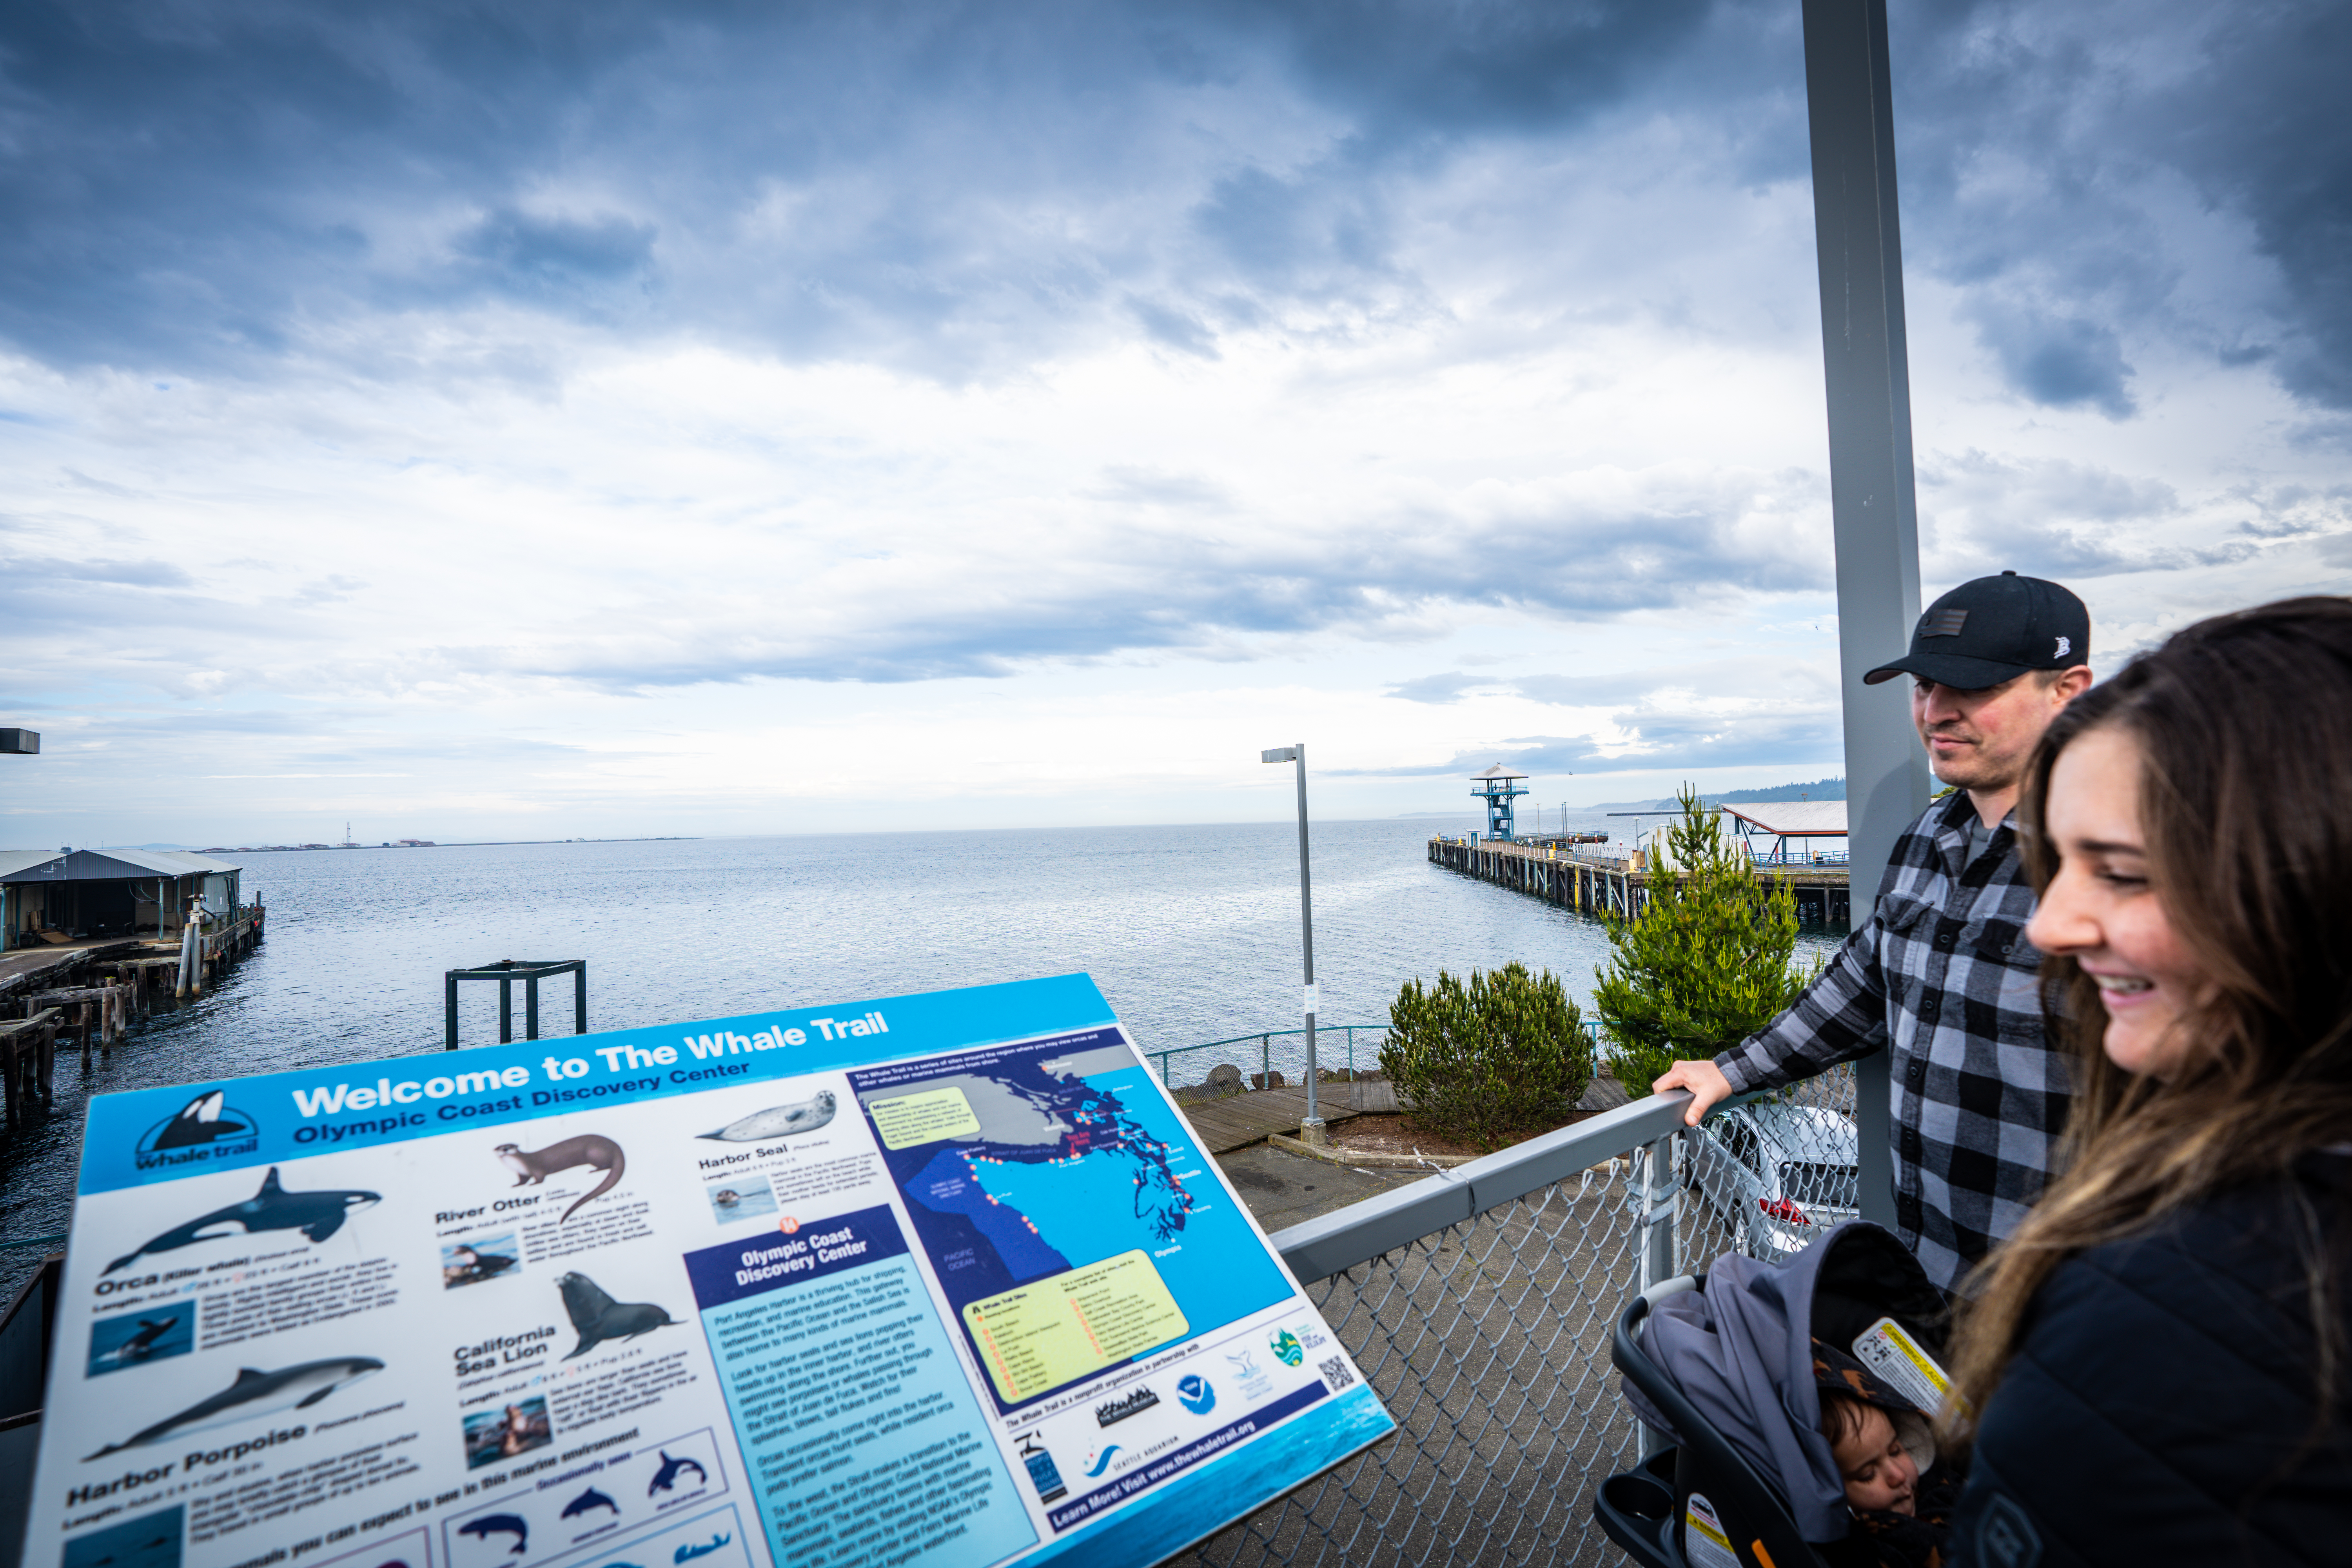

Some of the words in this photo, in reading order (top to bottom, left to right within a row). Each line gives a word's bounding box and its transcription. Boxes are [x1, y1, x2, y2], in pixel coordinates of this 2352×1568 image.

[292, 1066, 530, 1117] Welcome
[541, 1056, 590, 1081] to
[595, 1044, 678, 1072] The
[683, 1024, 807, 1060] Whale
[809, 1011, 889, 1041] Trail
[877, 1075, 902, 1083] whales
[934, 1064, 965, 1073] mammals
[963, 1053, 985, 1062] around
[292, 1111, 426, 1144] Olympic
[436, 1095, 523, 1121] Coast
[531, 1076, 661, 1106] Discovery
[669, 1063, 750, 1083] Center
[214, 1138, 259, 1158] trail
[699, 1153, 750, 1169] Harbor
[755, 1143, 788, 1158] Seal
[435, 1207, 485, 1224] River
[492, 1195, 540, 1212] Otter
[735, 1254, 815, 1286] Discovery
[817, 1240, 867, 1264] Center
[740, 1239, 808, 1269] Olympic
[808, 1226, 854, 1251] Coast
[93, 1270, 160, 1298] Orca
[454, 1327, 556, 1362] California
[455, 1357, 496, 1377] Sea
[503, 1343, 548, 1364] Lion
[1005, 1419, 1019, 1428] The
[1020, 1409, 1042, 1422] Whale
[1044, 1401, 1059, 1412] Trail
[1074, 1383, 1103, 1400] nonprofit
[1105, 1368, 1143, 1387] organization
[1152, 1350, 1185, 1369] partnership
[1187, 1343, 1199, 1352] with
[65, 1463, 174, 1508] Harbor
[184, 1426, 305, 1472] Porpoise
[1113, 1453, 1141, 1471] SEATTLE
[1144, 1436, 1178, 1456] AQUARIUM
[1053, 1503, 1089, 1527] Learn
[1087, 1484, 1122, 1510] More!
[1120, 1473, 1147, 1492] Visit
[1147, 1420, 1256, 1480] www.thewhaletrail.org
[291, 1537, 322, 1559] you
[325, 1525, 356, 1544] can
[359, 1504, 412, 1532] expect
[416, 1499, 431, 1512] to
[435, 1490, 460, 1506] see
[464, 1484, 477, 1495] in
[481, 1474, 507, 1489] this
[511, 1457, 557, 1479] marine
[561, 1428, 638, 1461] environment
